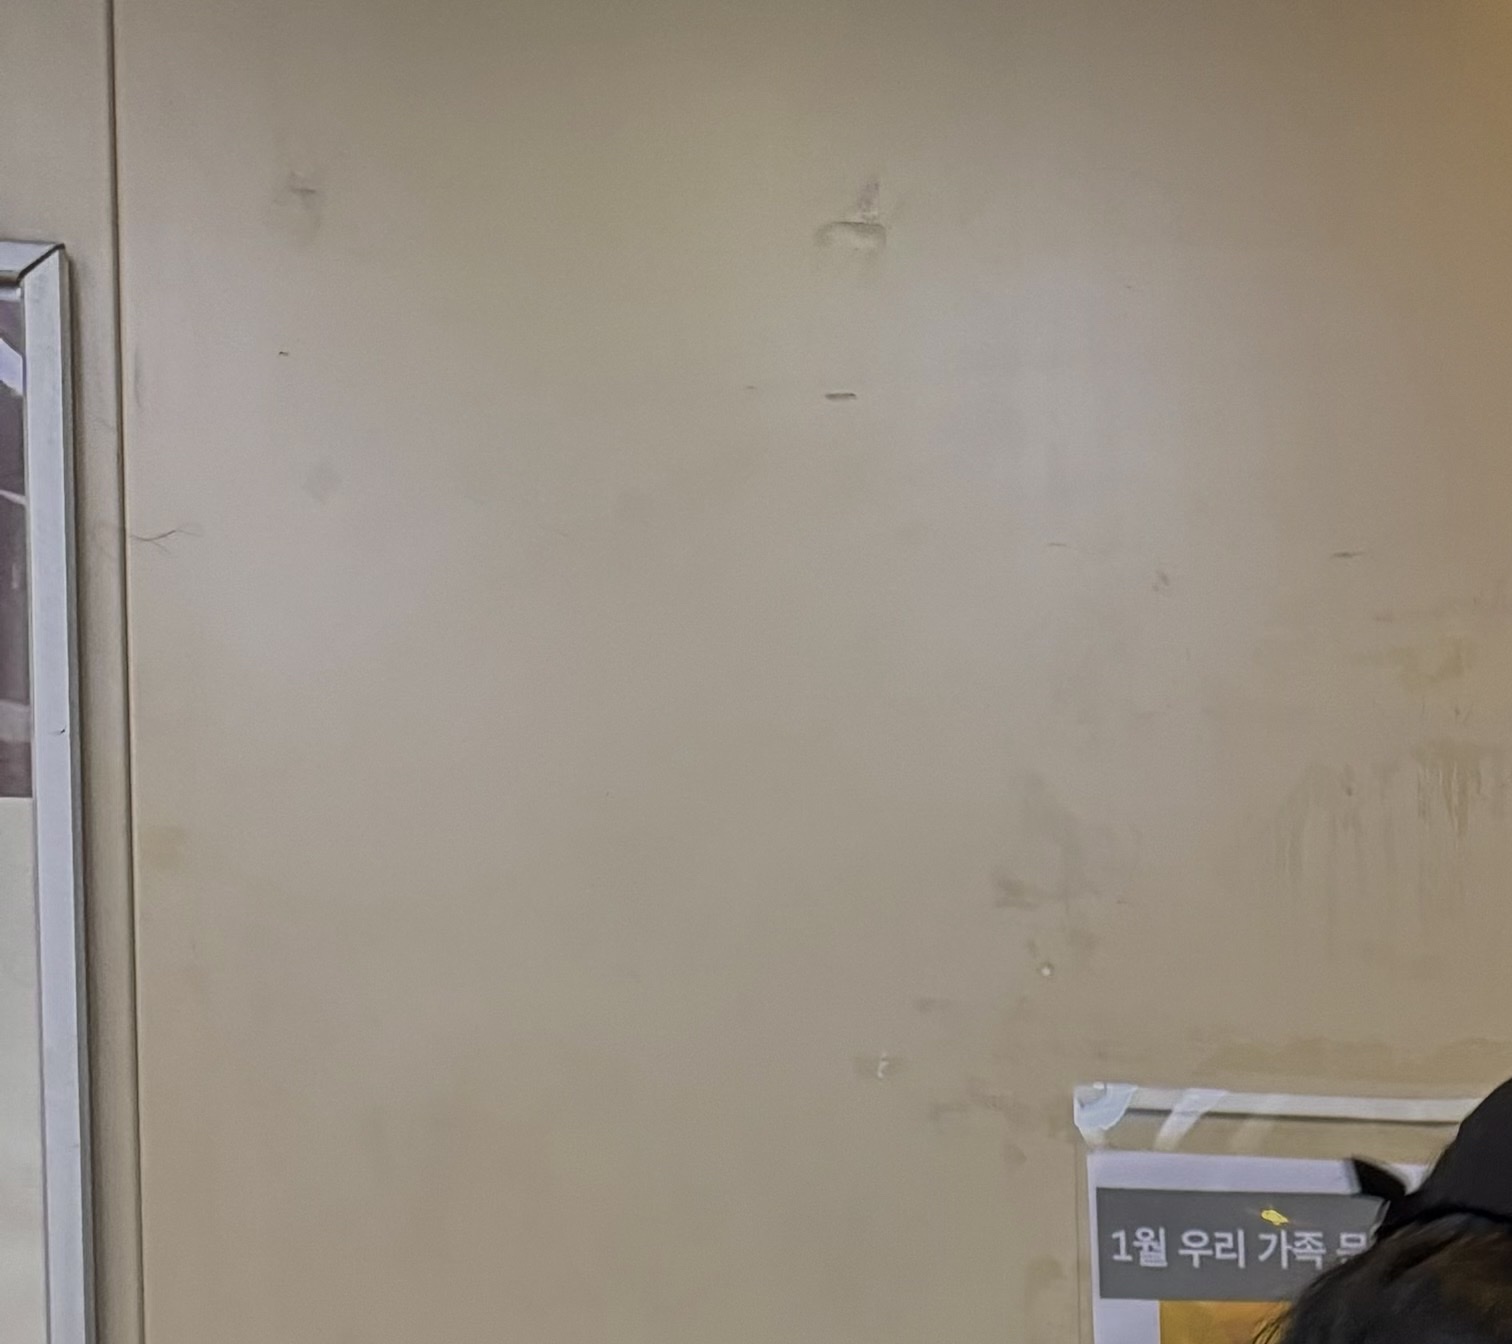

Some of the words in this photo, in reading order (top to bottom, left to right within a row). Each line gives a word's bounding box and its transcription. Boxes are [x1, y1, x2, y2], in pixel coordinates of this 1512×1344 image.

[1111, 1226, 1168, 1268] 1월
[1178, 1227, 1246, 1269] 우리
[1258, 1228, 1327, 1270] 가족
